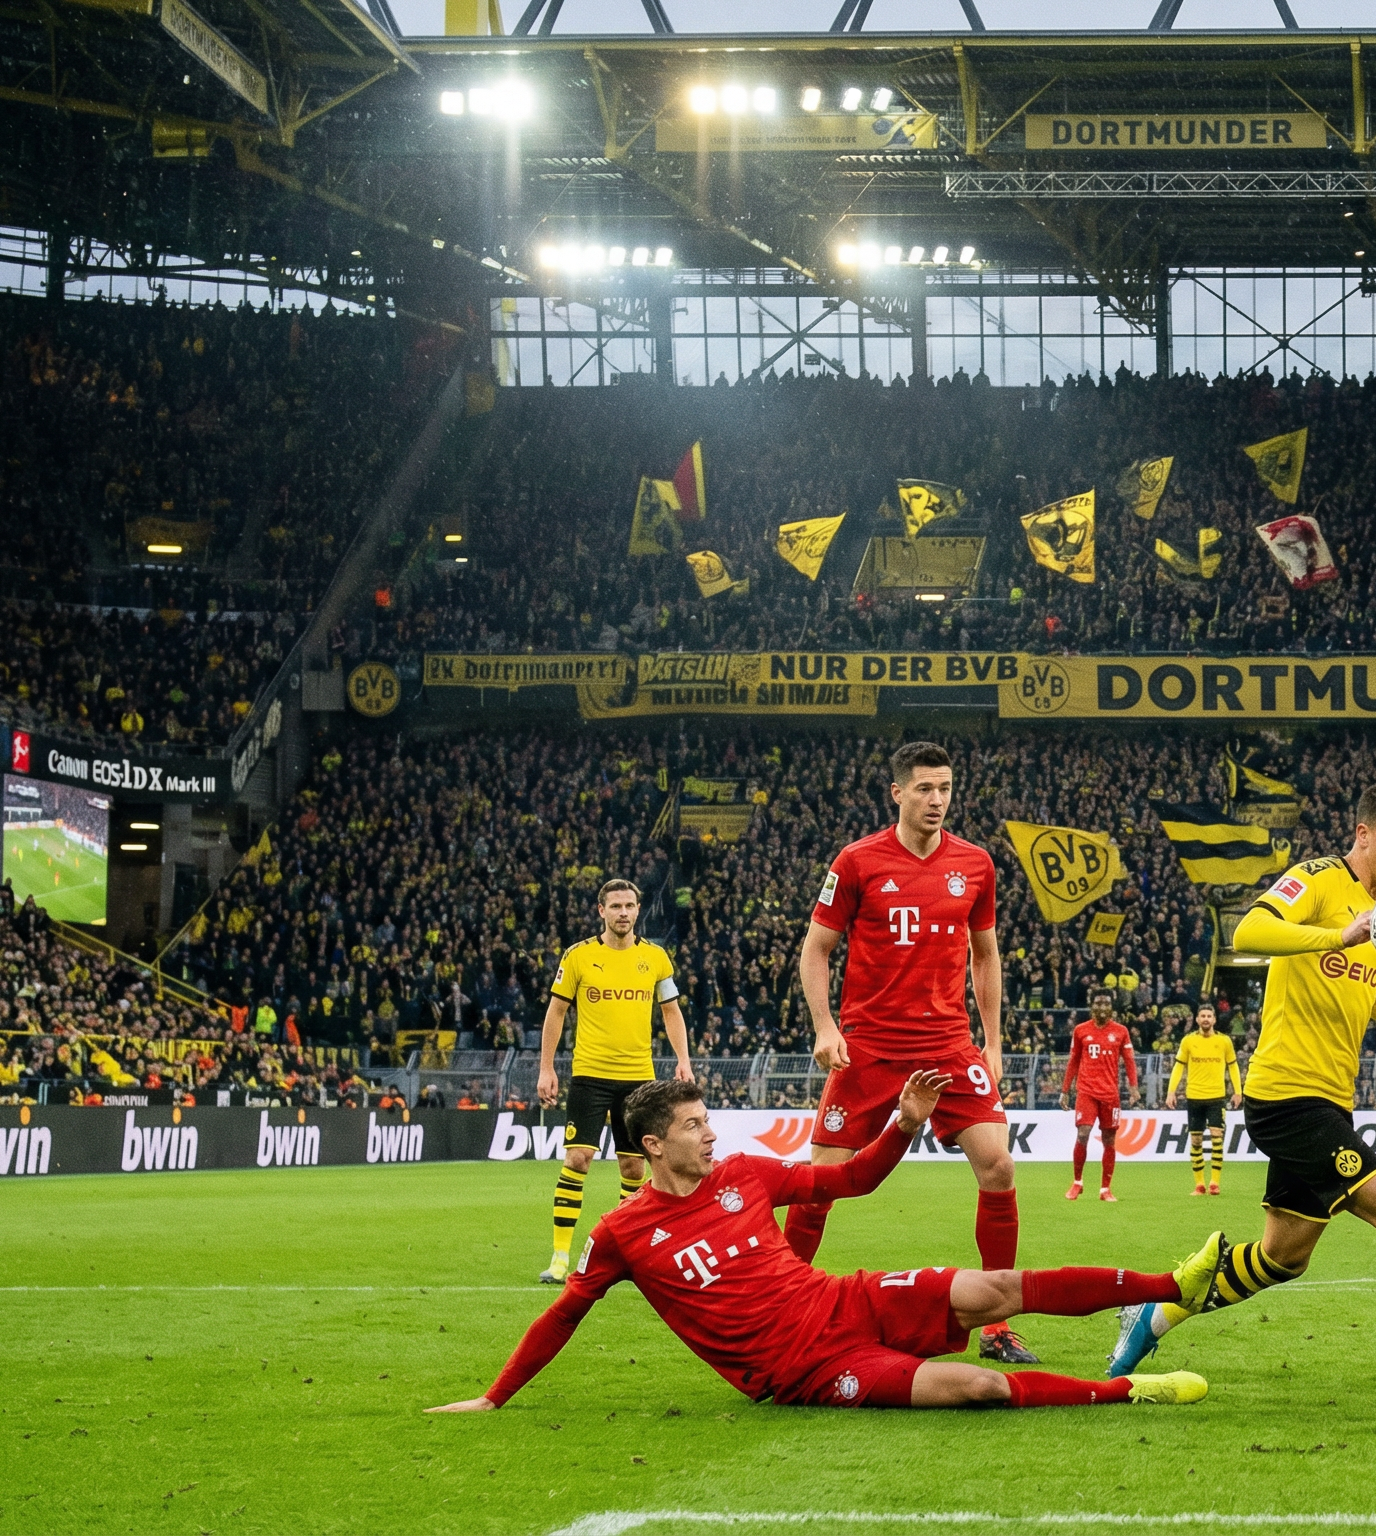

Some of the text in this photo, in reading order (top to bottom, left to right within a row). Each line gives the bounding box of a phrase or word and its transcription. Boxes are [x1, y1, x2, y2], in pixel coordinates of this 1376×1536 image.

[1052, 119, 1293, 145] DORTMUNDER
[355, 669, 395, 699] BVB
[770, 655, 1019, 682] NUR DER BVB
[1023, 664, 1065, 697] BVB
[48, 749, 88, 780] Canon
[166, 776, 200, 792] Mark
[1039, 834, 1100, 884] BVB
[1066, 876, 1089, 896] 09
[967, 1064, 991, 1096] 9
[0, 1105, 51, 1175] win
[121, 1107, 198, 1172] bwin
[256, 1108, 321, 1167] bwin
[366, 1109, 424, 1164] bwin
